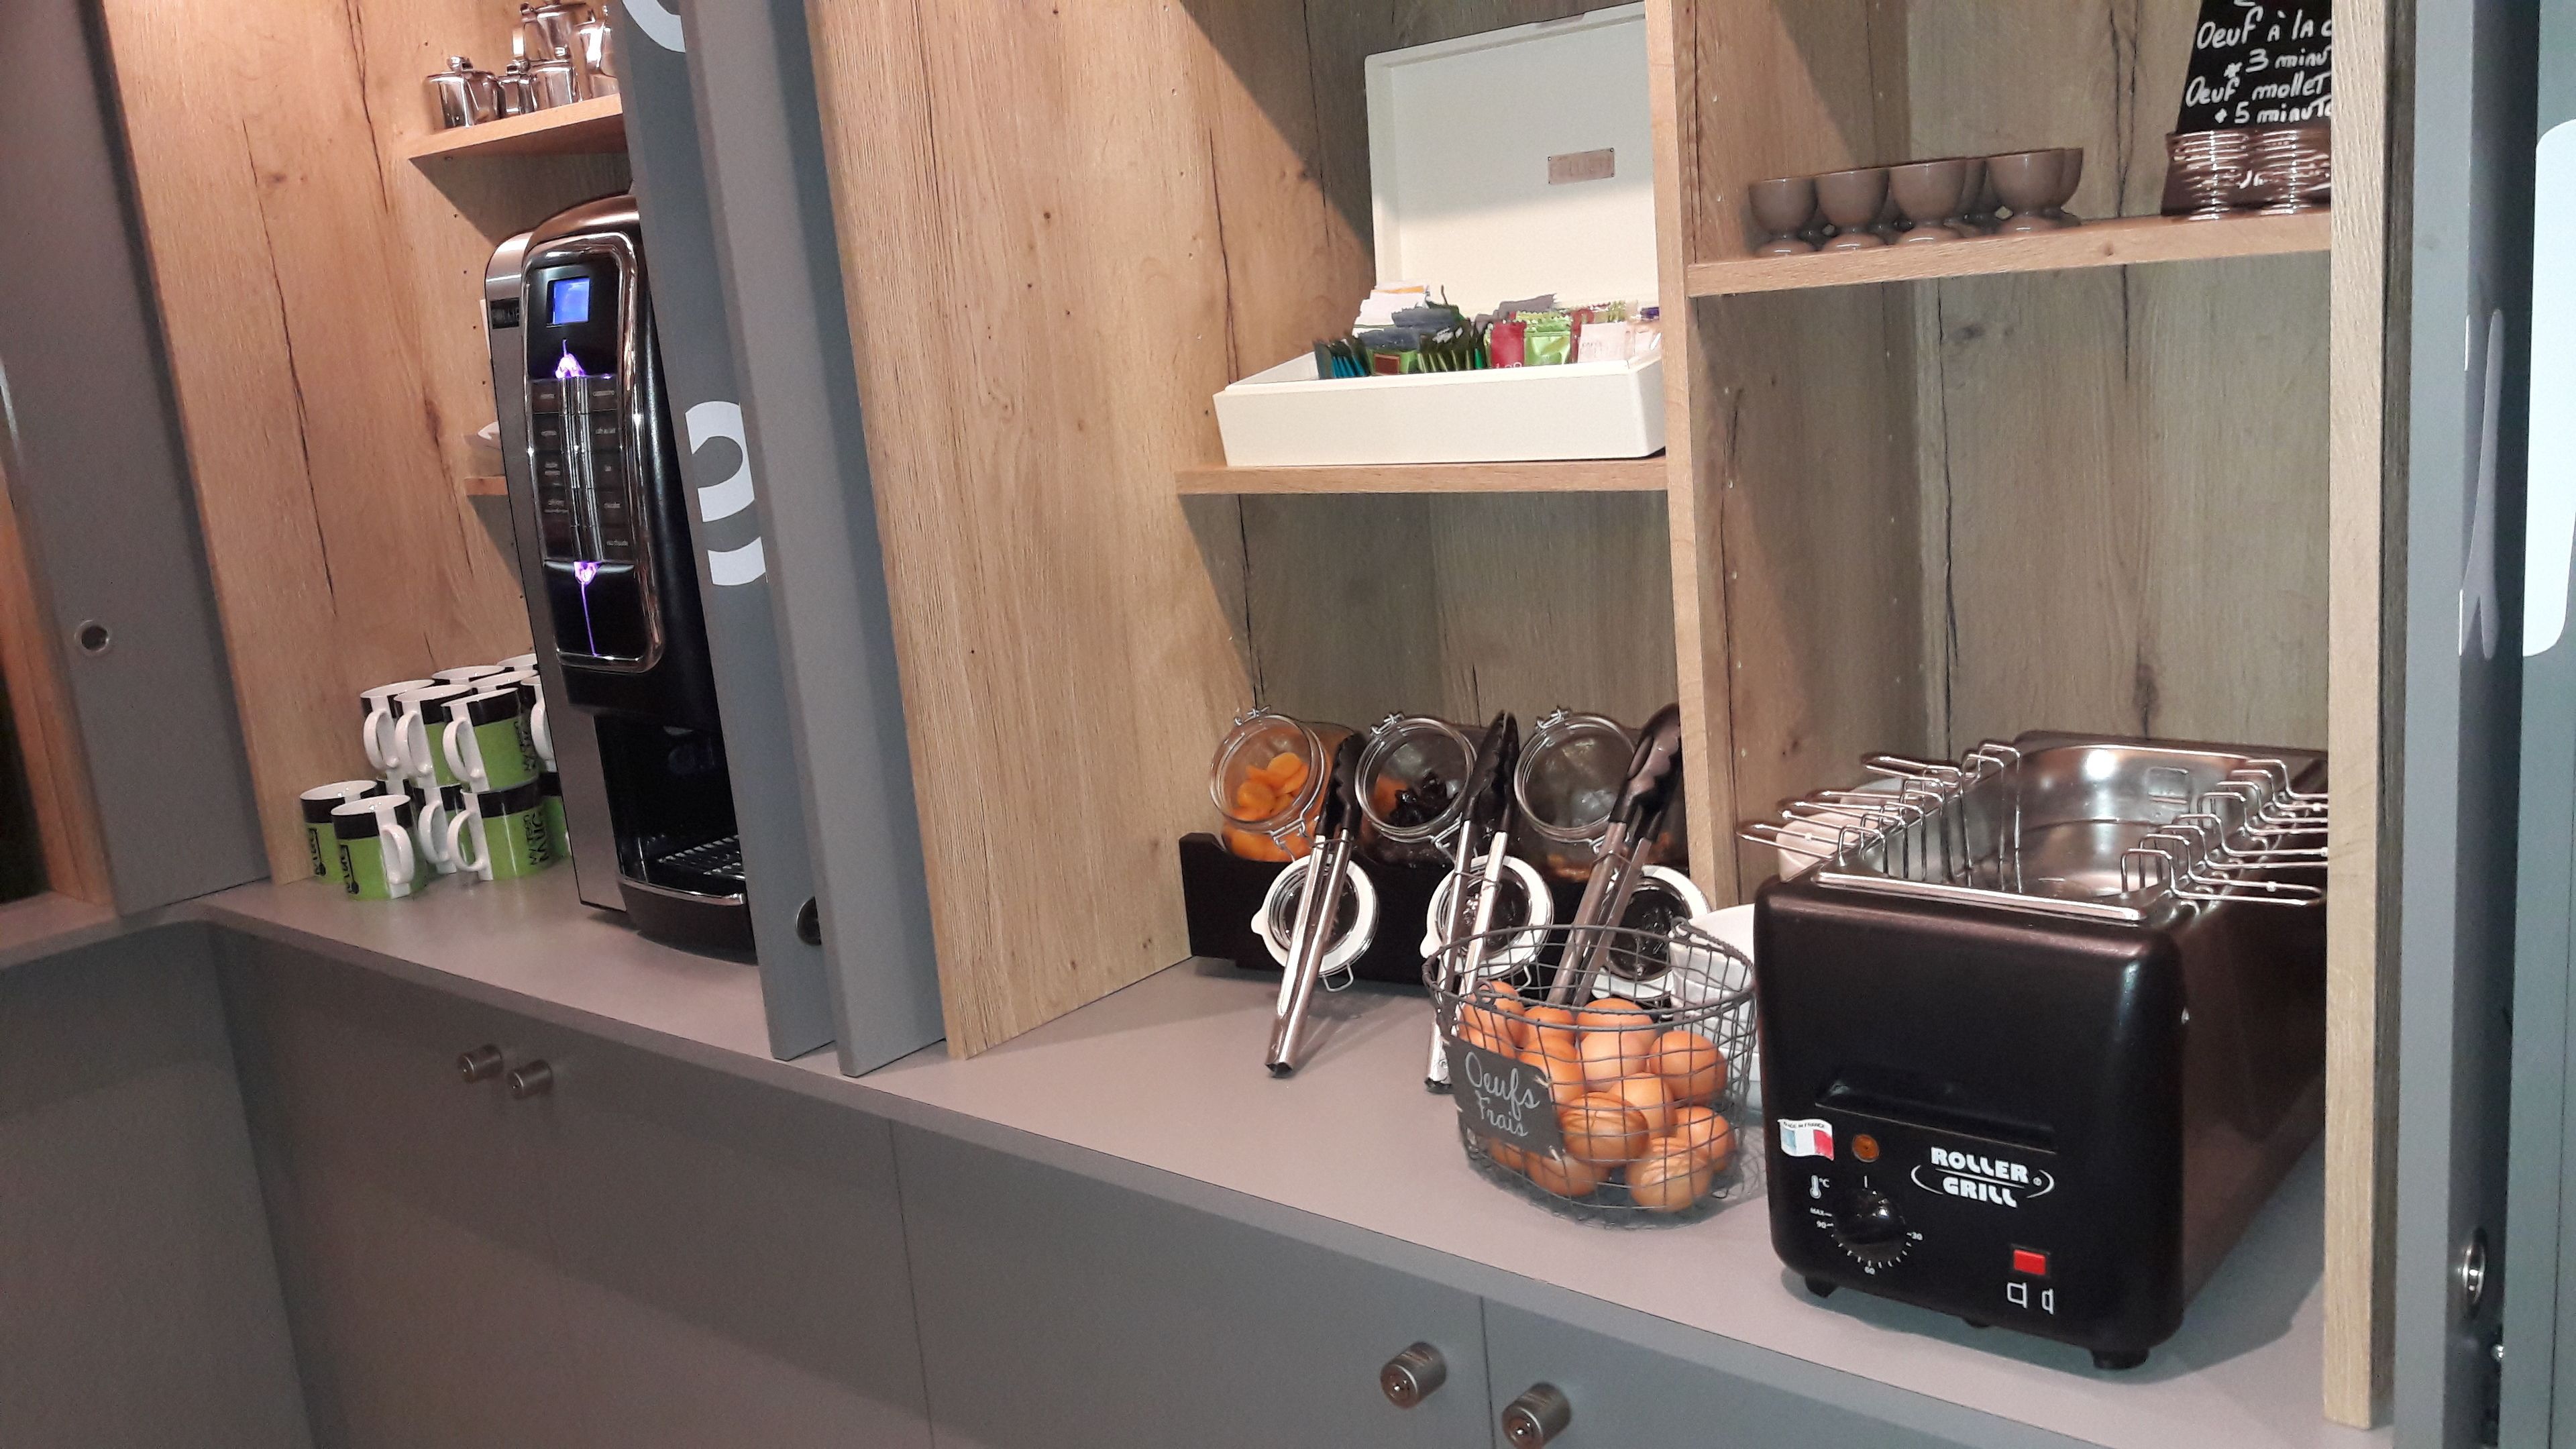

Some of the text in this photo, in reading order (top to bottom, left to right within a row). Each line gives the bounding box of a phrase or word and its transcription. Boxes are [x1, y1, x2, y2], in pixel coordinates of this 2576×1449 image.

[2196, 5, 2263, 49] Oeuf
[2245, 48, 2269, 72] 3
[2185, 75, 2241, 107] Oeuf
[2235, 101, 2249, 124] 5
[1465, 1051, 1540, 1121] Oeufs
[1474, 1089, 1529, 1137] Frais
[1931, 1146, 2029, 1184] ROLLER
[1943, 1176, 2017, 1208] GRILL
[1911, 1232, 1923, 1241] 30
